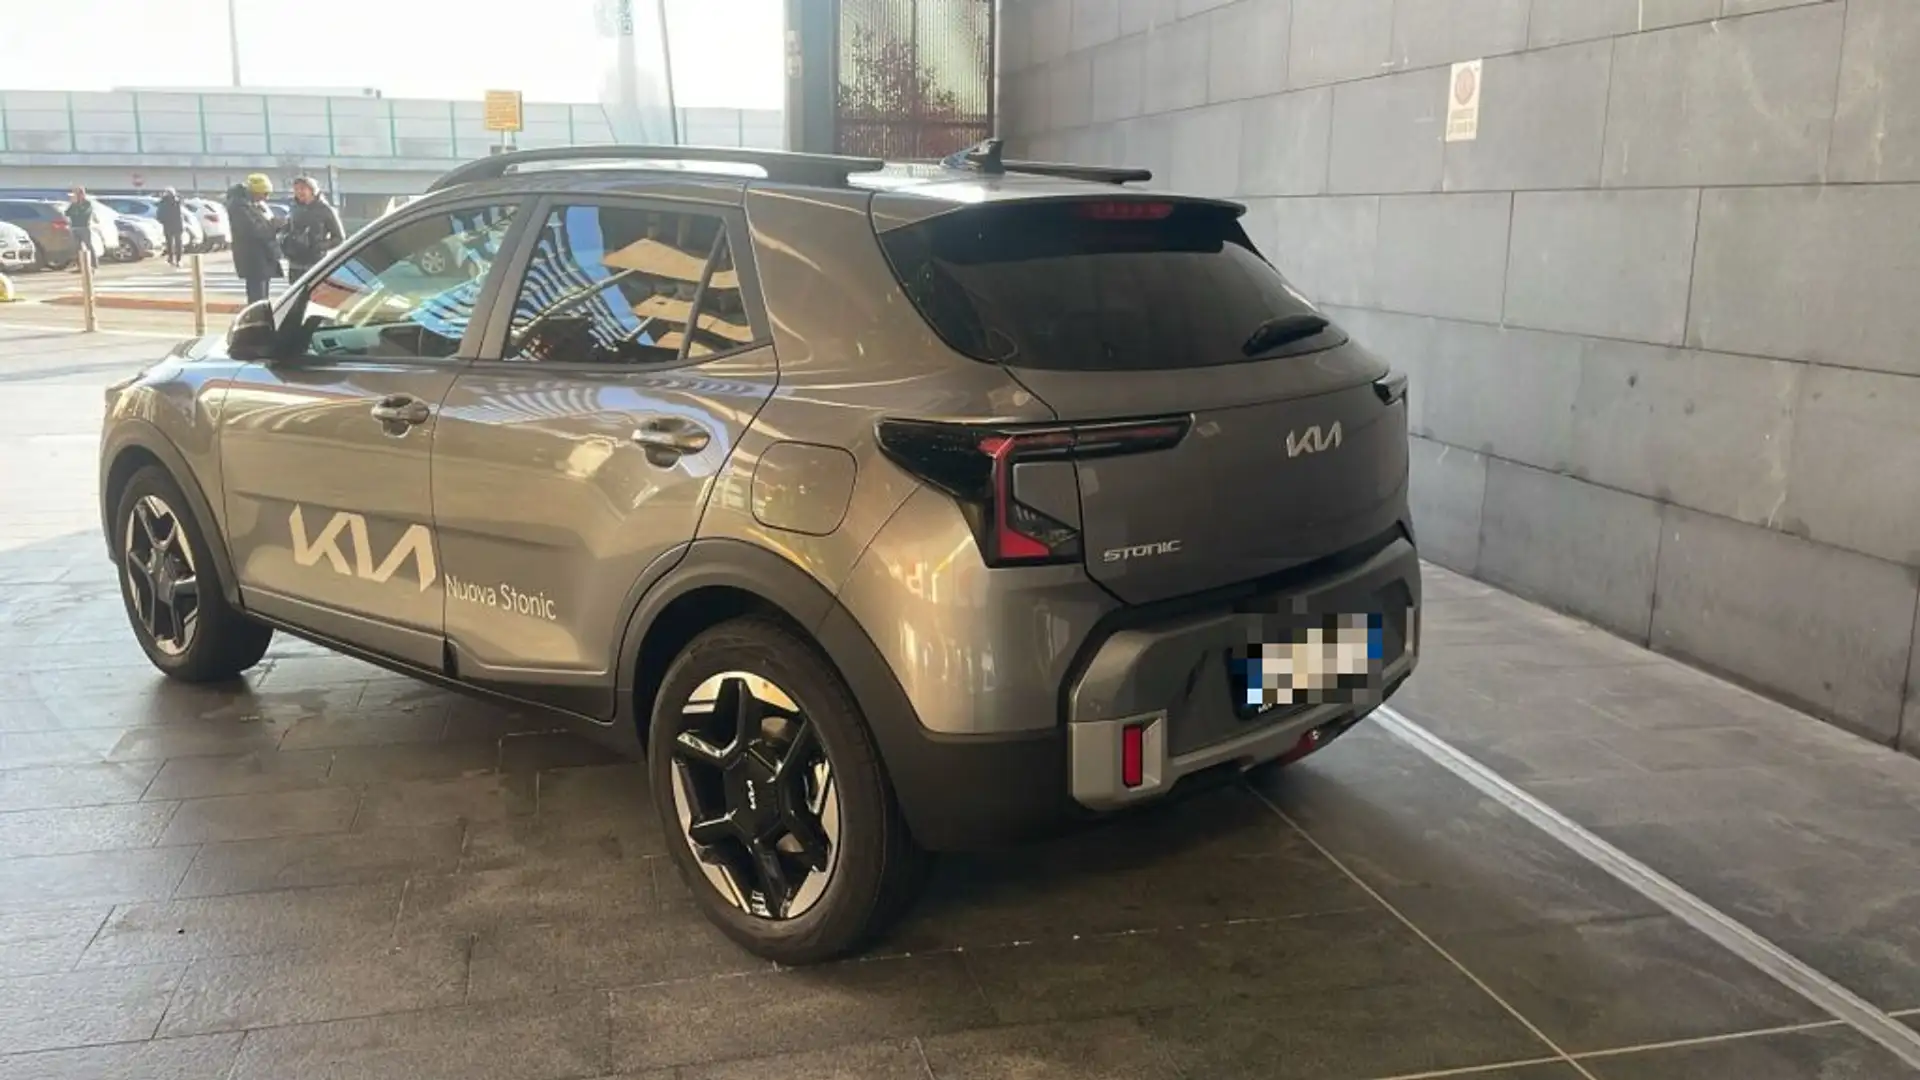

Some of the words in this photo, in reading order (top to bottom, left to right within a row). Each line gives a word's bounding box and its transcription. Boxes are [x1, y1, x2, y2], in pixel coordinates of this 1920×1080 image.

[1286, 420, 1342, 458] KIA
[289, 503, 437, 592] KIA
[1103, 540, 1182, 562] STONIC
[445, 572, 497, 606] Nuova
[500, 583, 557, 620] Stonic
